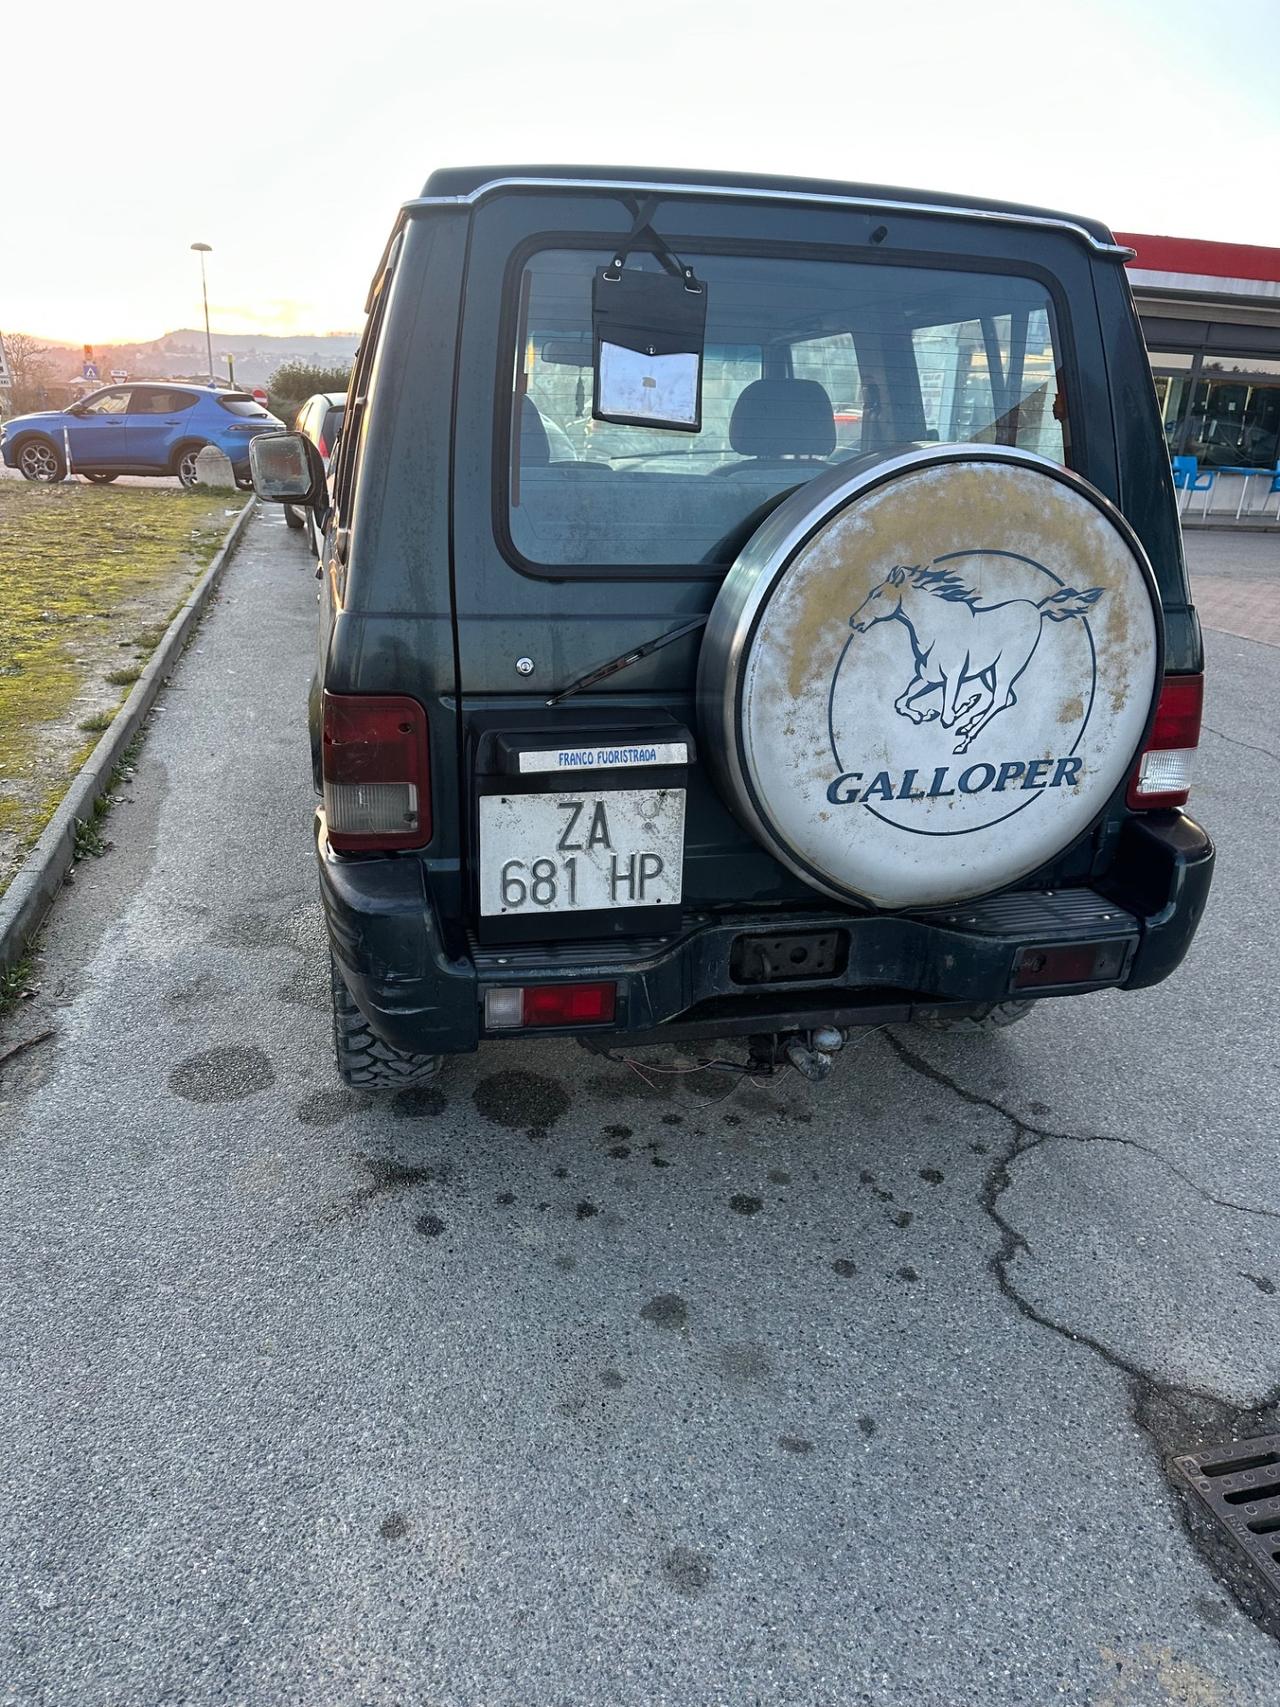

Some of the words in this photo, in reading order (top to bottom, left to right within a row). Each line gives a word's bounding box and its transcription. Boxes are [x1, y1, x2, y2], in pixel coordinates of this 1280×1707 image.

[559, 751, 594, 766] FRANCO
[597, 748, 656, 765] FUORISTRADA
[827, 757, 1083, 805] GALLOPER
[556, 799, 612, 851] ZA
[501, 854, 578, 908] 681
[609, 851, 664, 902] HP
